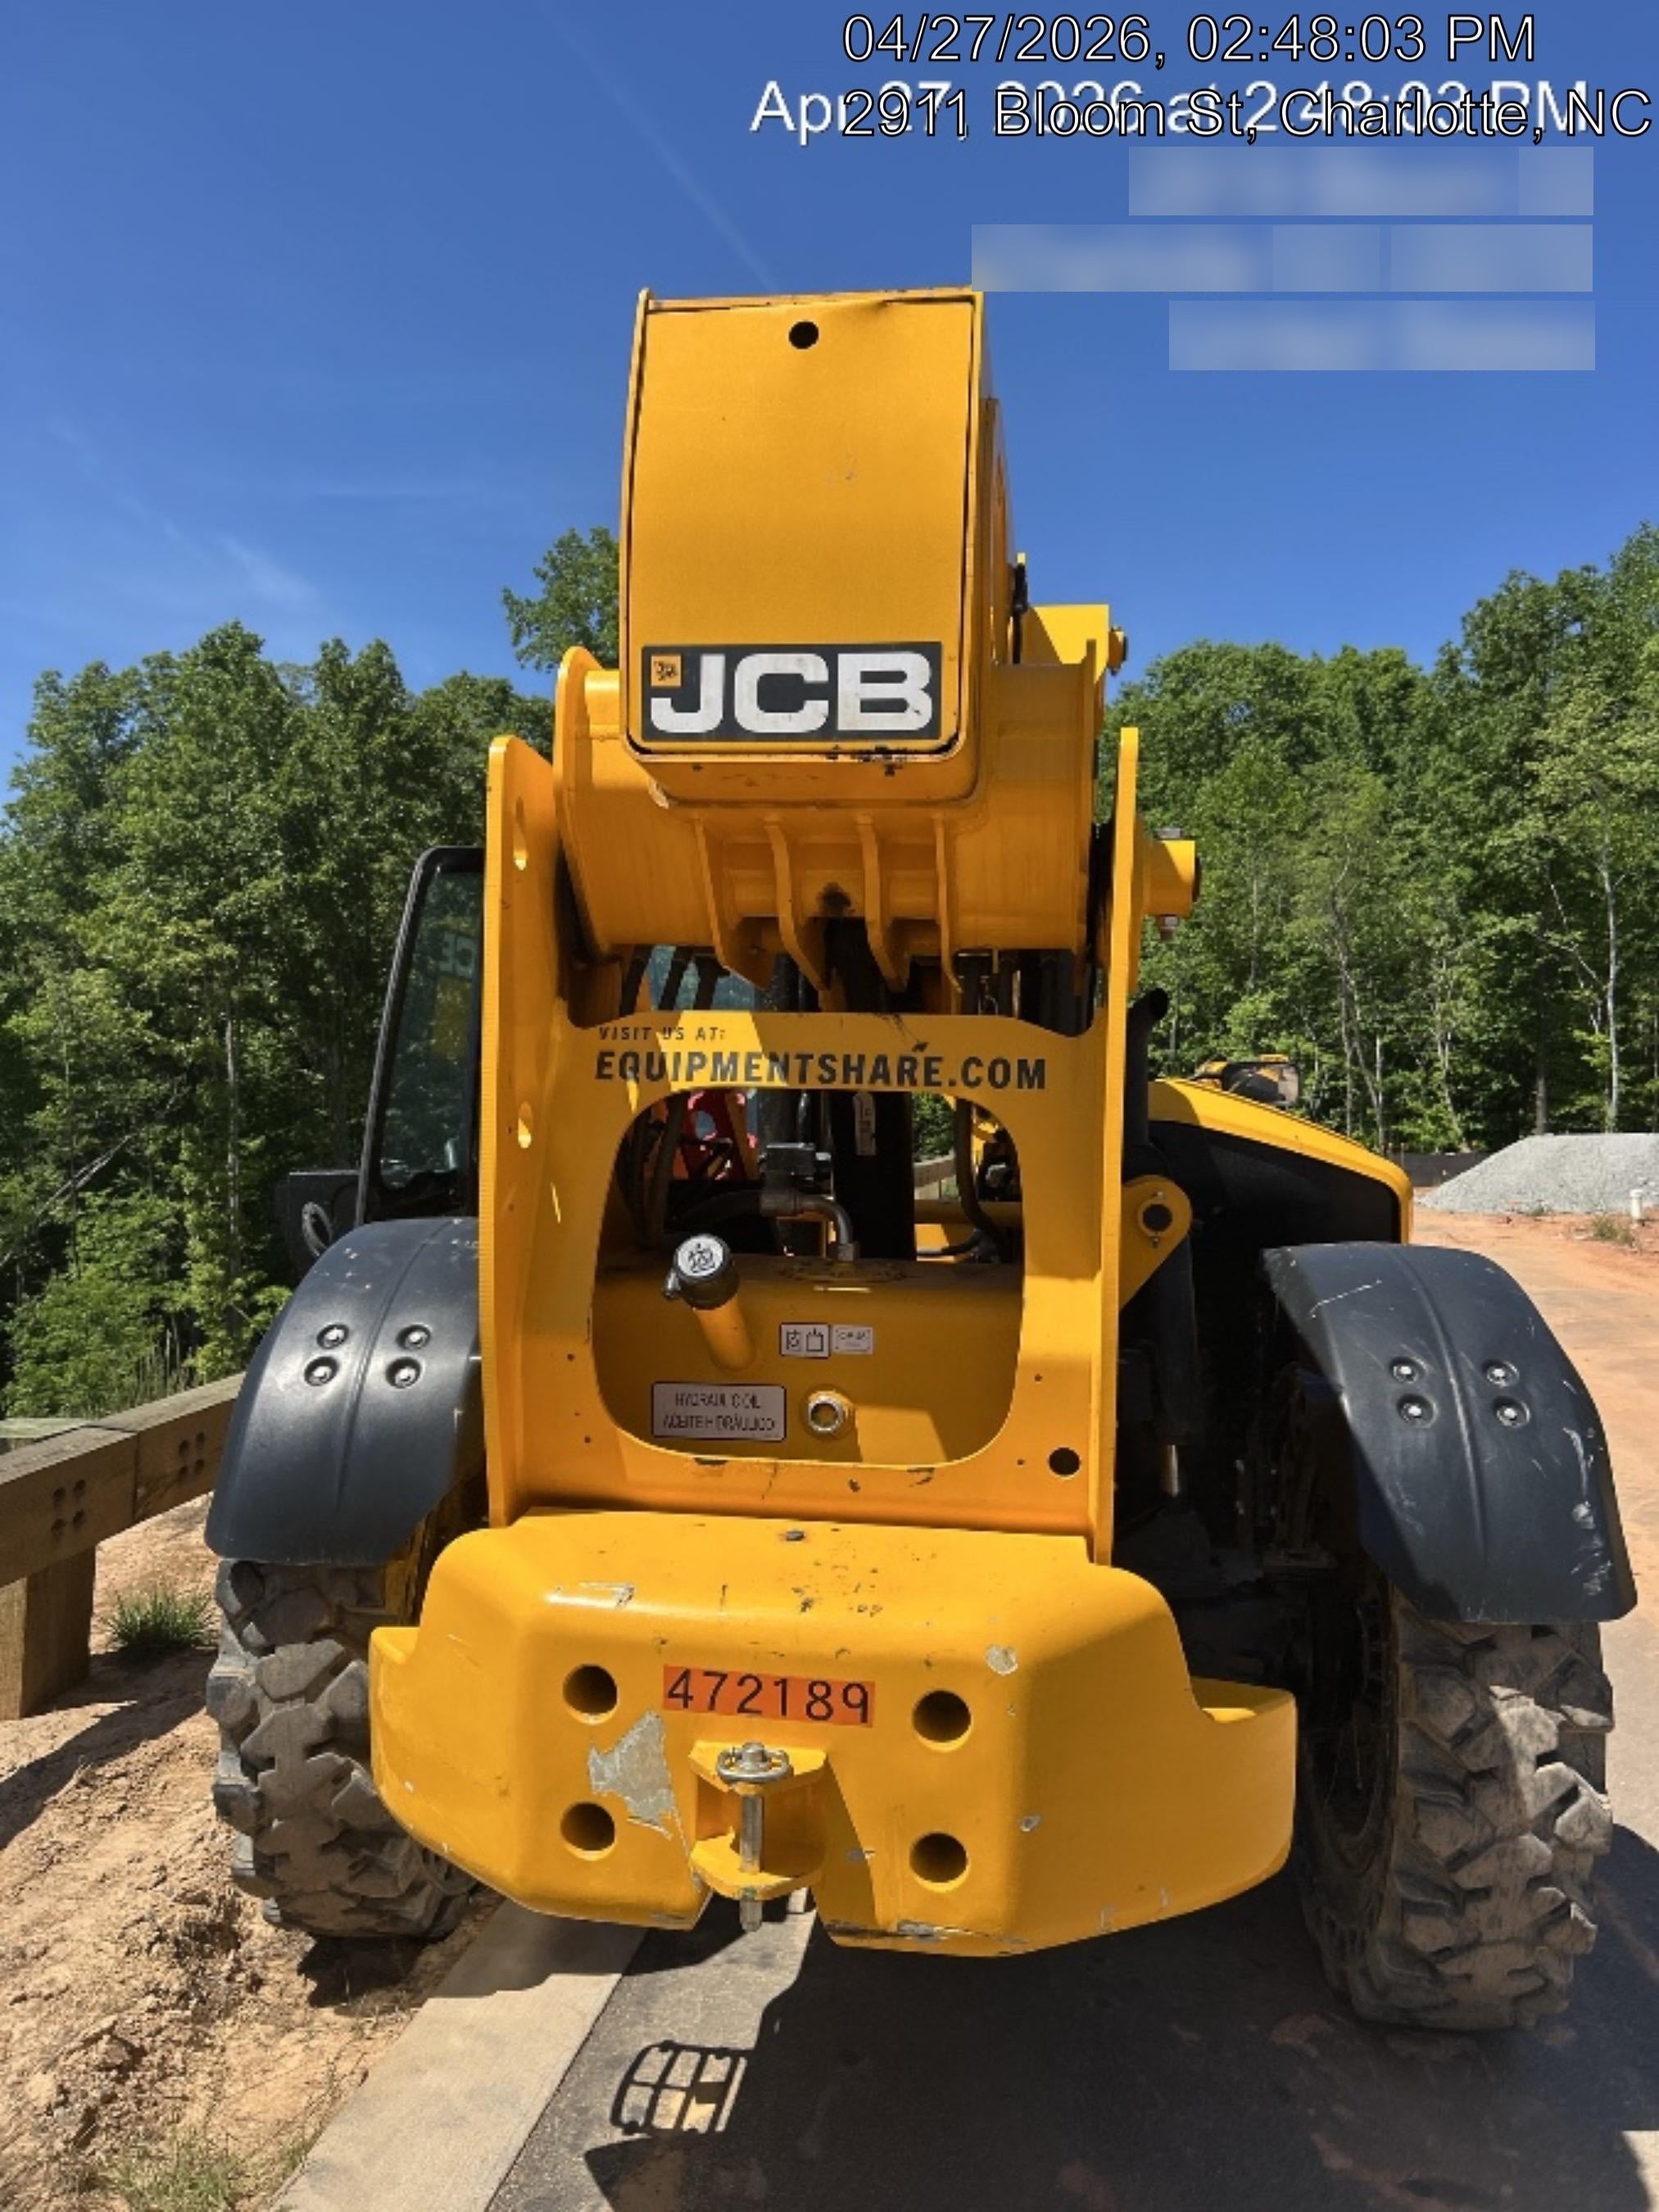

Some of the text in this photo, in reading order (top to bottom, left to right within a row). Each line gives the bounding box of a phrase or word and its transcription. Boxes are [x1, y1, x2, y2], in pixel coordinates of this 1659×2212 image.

[650, 652, 933, 733] JCB
[599, 1027, 652, 1040] VISIT
[662, 1027, 685, 1041] US
[595, 1050, 1046, 1090] EQUIPMENTSHARE.COM
[667, 1668, 868, 1724] 472189
